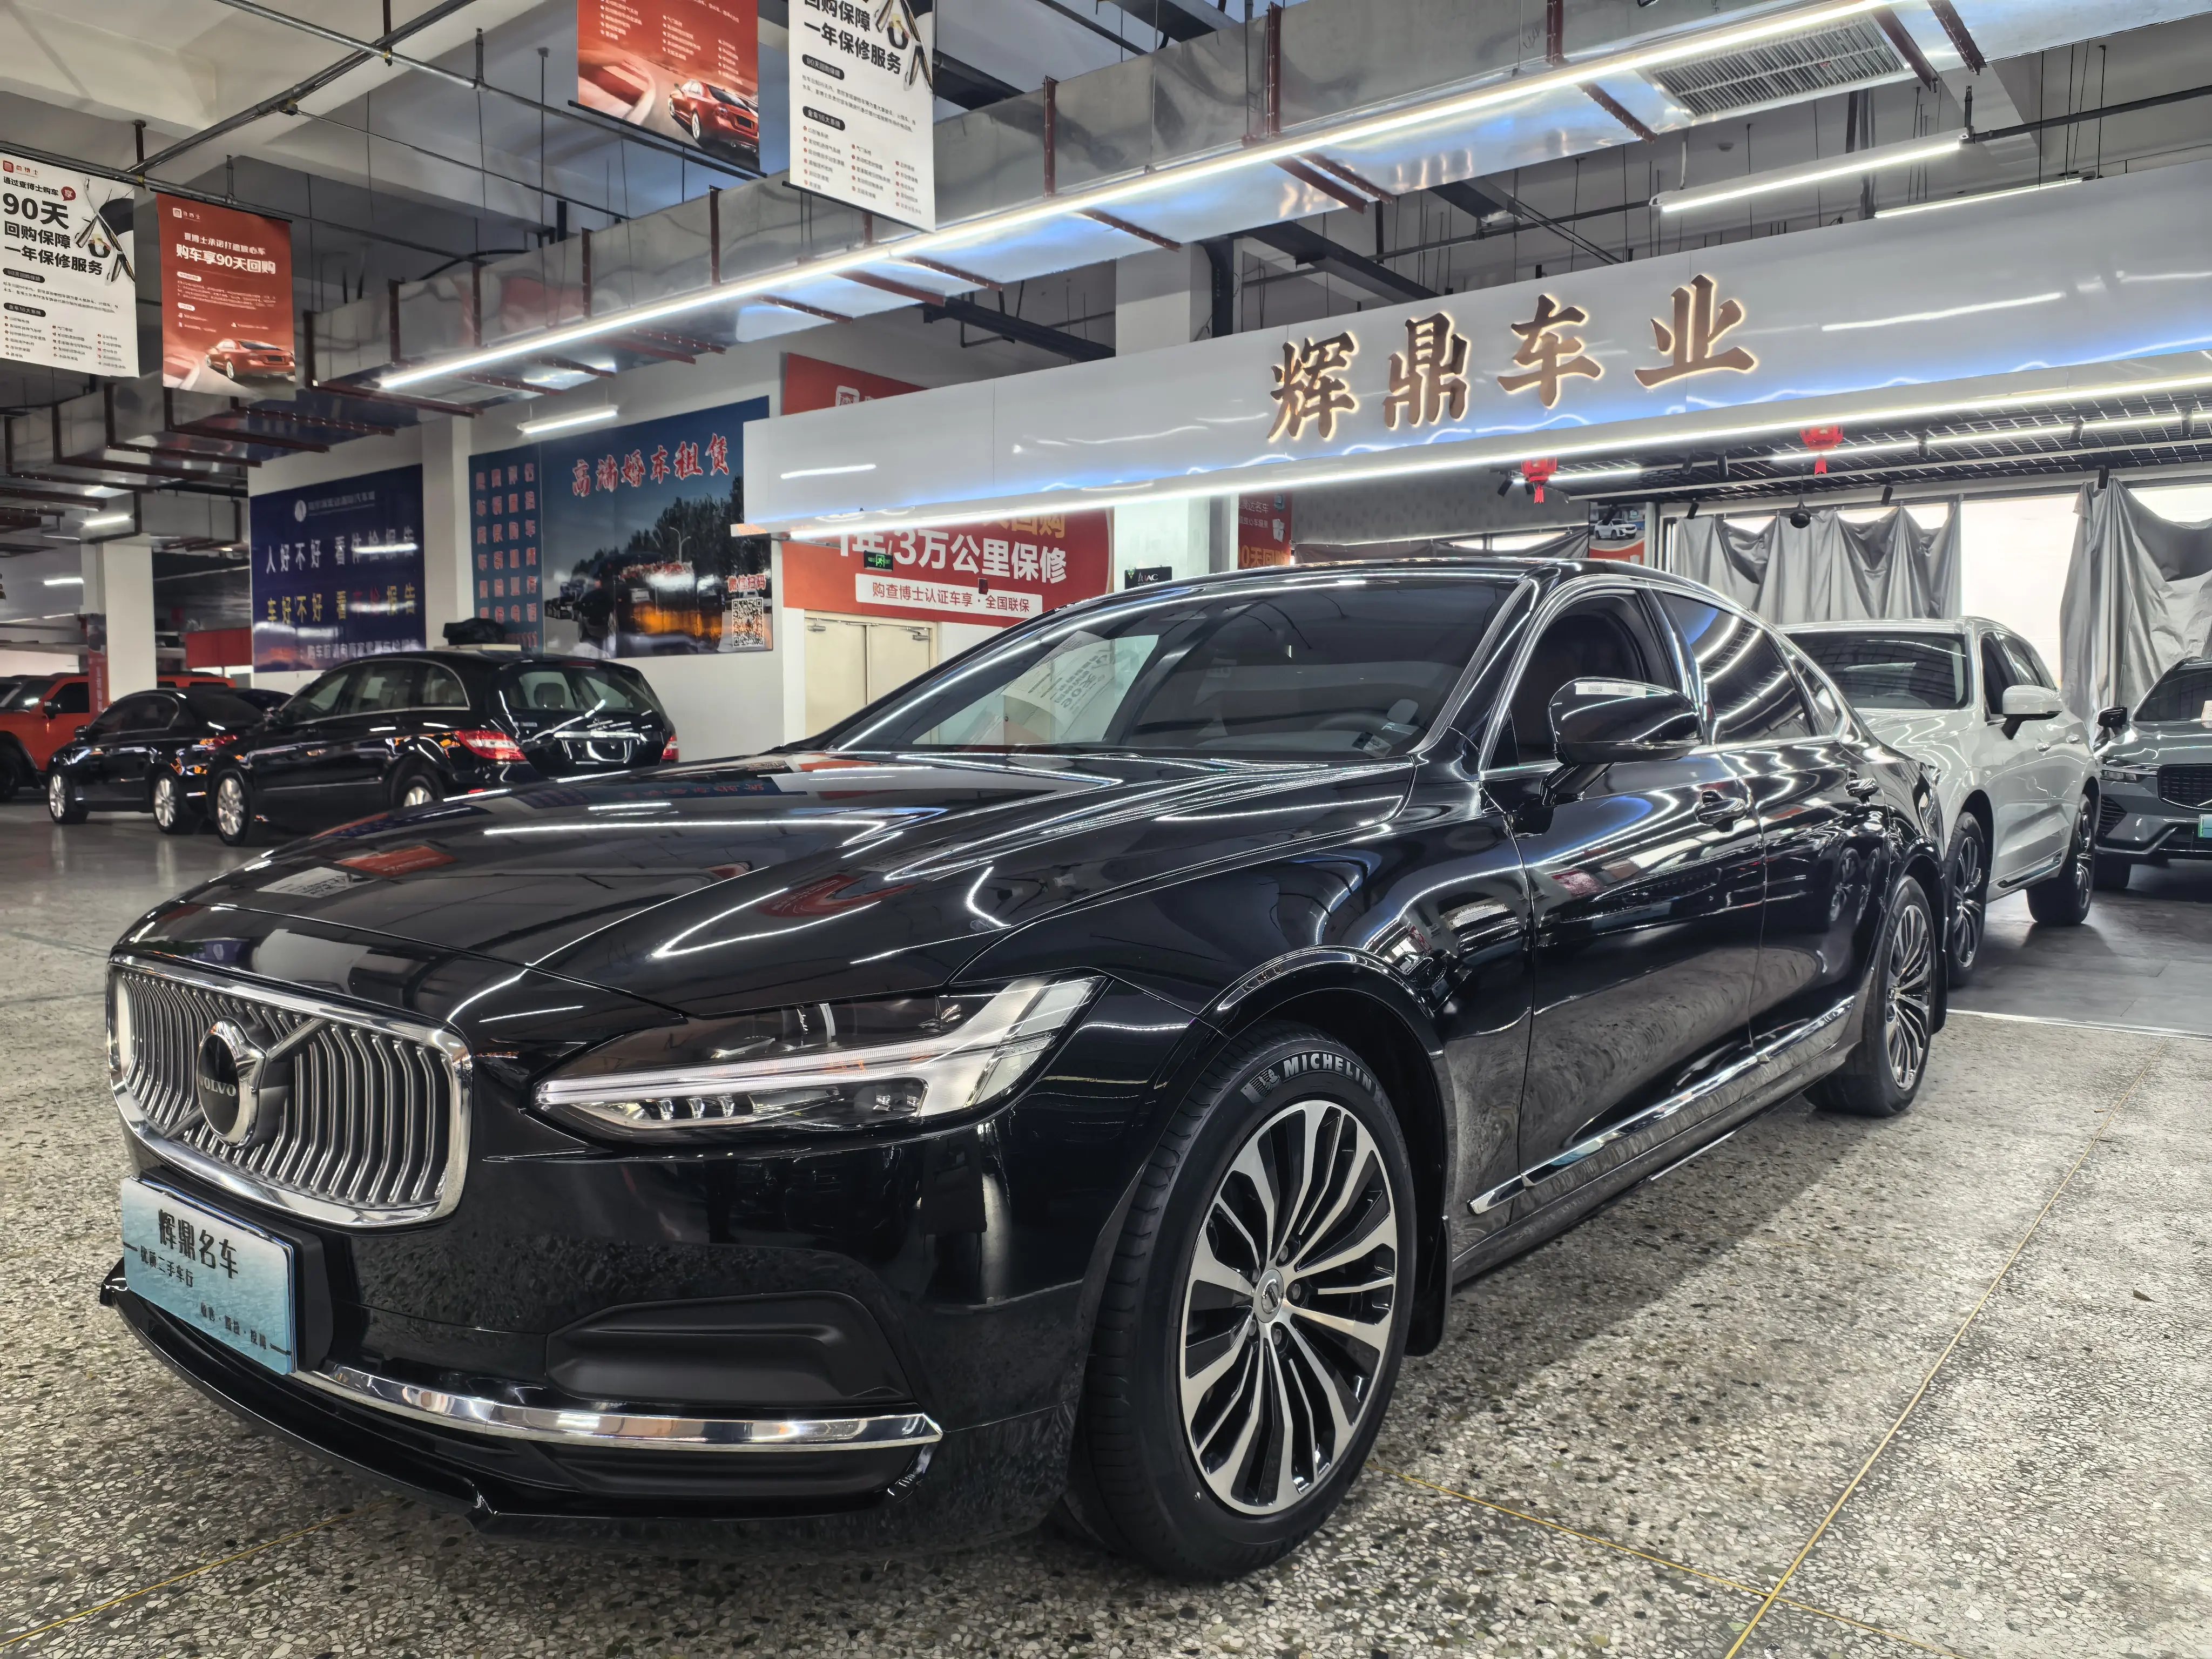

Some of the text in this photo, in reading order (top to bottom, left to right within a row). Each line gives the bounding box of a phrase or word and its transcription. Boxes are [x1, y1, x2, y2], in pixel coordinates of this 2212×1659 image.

[804, 22, 901, 75] 一年保修服务
[3, 193, 69, 230] 90天
[4, 220, 71, 249] 回购保障
[4, 245, 103, 275] 一年保修服务
[176, 243, 276, 274] 购车享90天回购
[1267, 273, 1758, 442] 辉鼎车业
[199, 1075, 237, 1097] VOLVO
[1283, 1053, 1373, 1091] MICHELIN
[158, 1209, 238, 1279] 辉鼎名车
